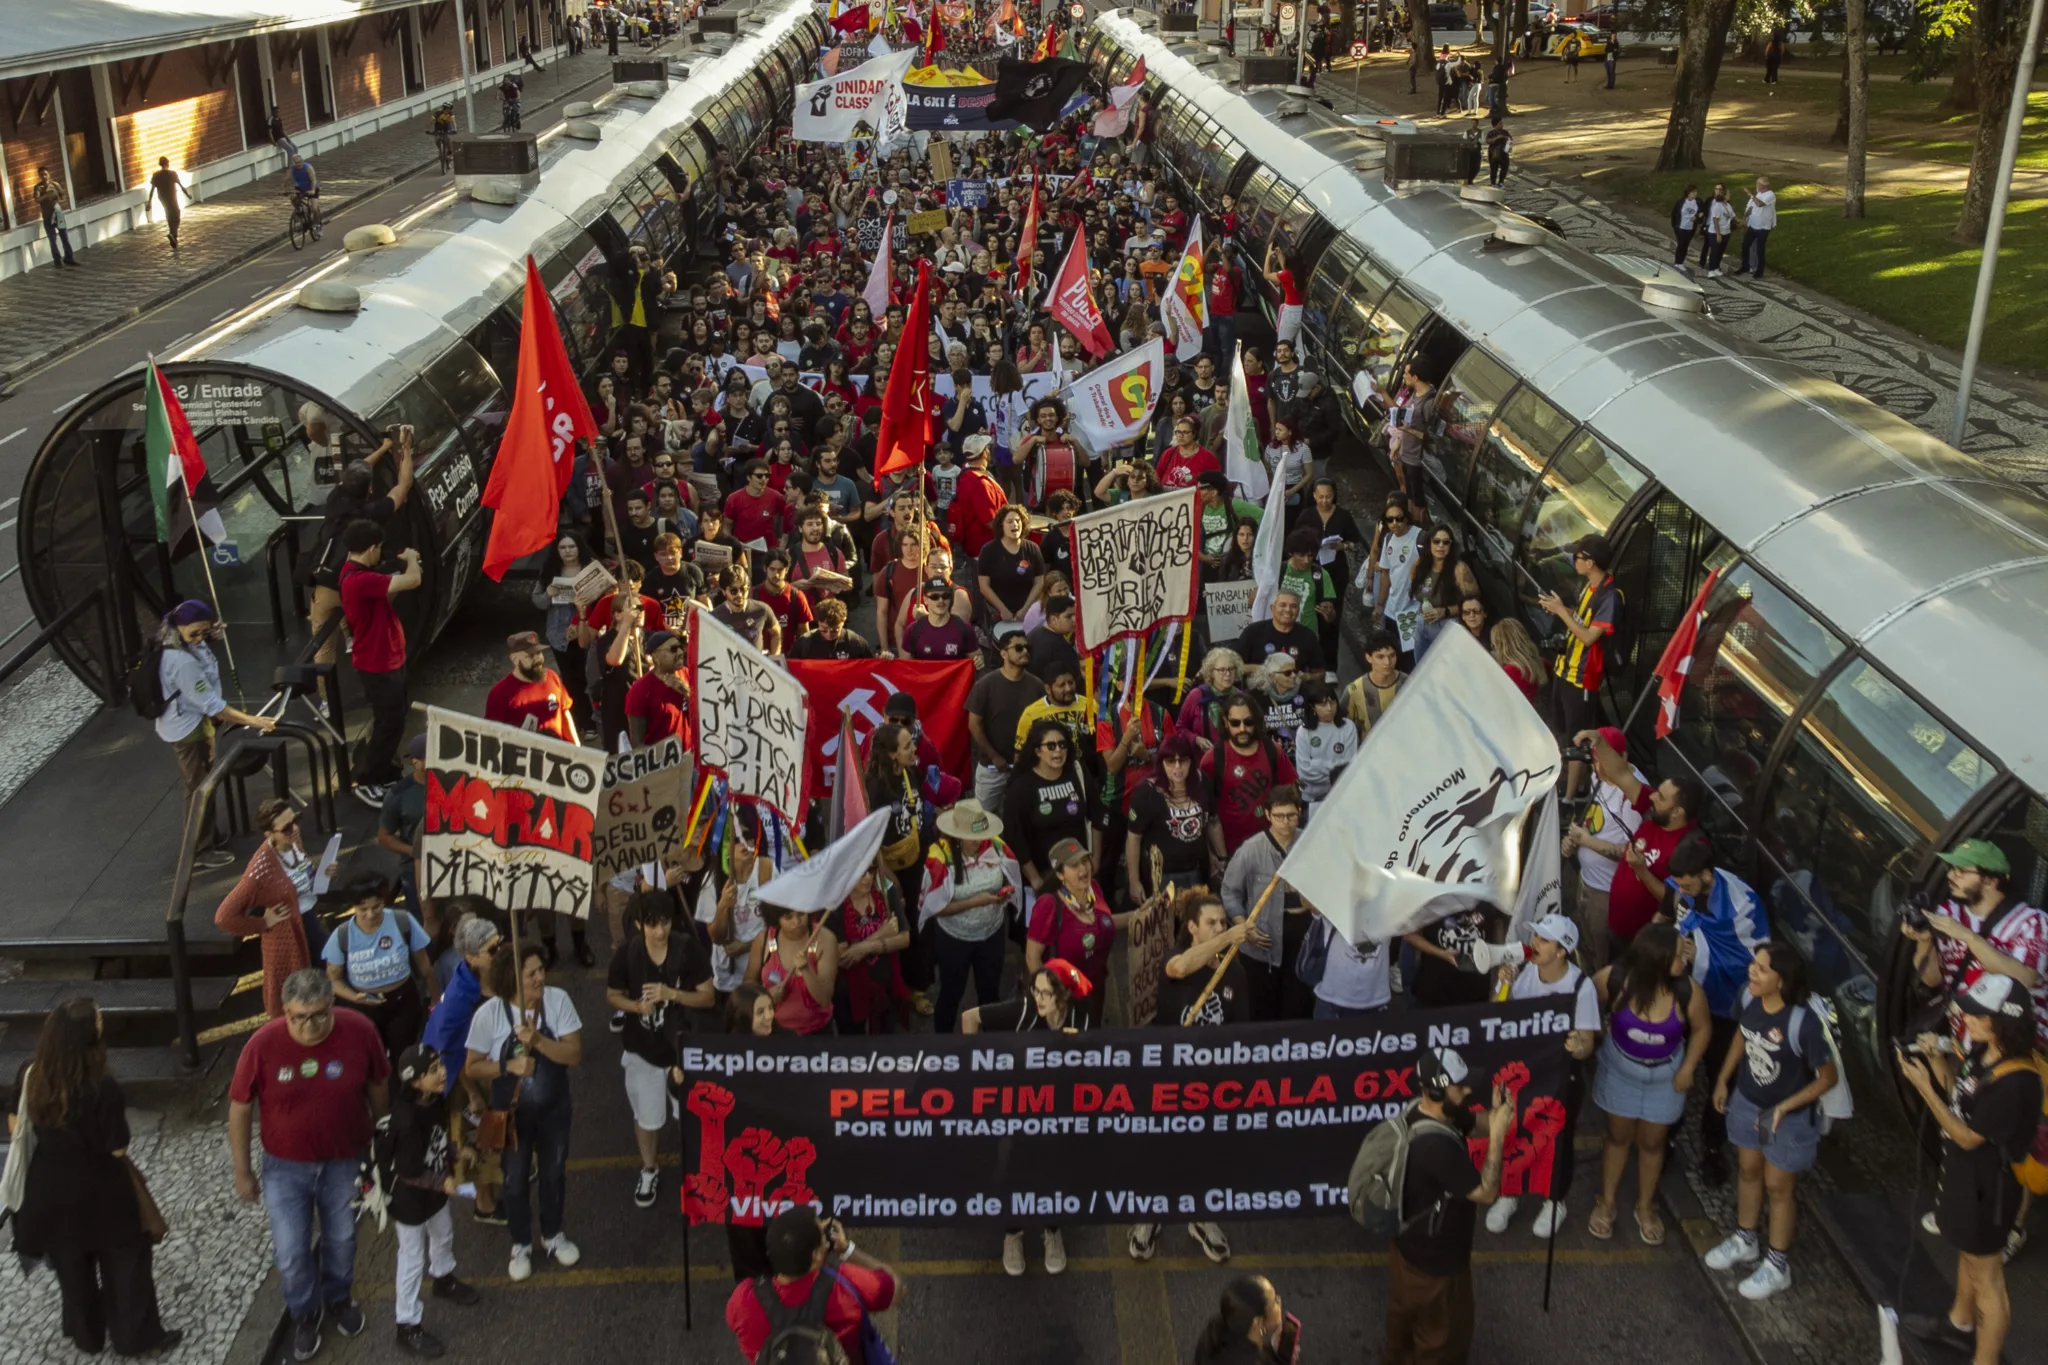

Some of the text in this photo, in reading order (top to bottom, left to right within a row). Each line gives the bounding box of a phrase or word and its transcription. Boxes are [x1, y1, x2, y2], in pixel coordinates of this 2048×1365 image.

[836, 79, 888, 95] UNIDAD
[836, 96, 872, 109] CLASS
[924, 96, 944, 108] 6X1
[859, 238, 906, 250] MODNA
[201, 384, 262, 399] Entrada
[181, 400, 212, 410] erminal
[216, 416, 241, 426] Santa
[456, 481, 479, 519] Correia
[1078, 522, 1115, 546] POR
[1097, 571, 1167, 613] TARIFA
[1208, 589, 1251, 604] TRABALH
[1208, 603, 1249, 616] TRABALH
[438, 724, 596, 794] DIREITO
[603, 740, 681, 789] SCALA
[1038, 781, 1075, 802] PUMA
[425, 769, 596, 866] MORAR
[1398, 767, 1466, 843] Movimento
[594, 822, 648, 857] DESU
[595, 842, 648, 880] MANO
[427, 848, 589, 918] DIREITOS
[349, 948, 375, 962] MEU
[351, 956, 391, 973] CORPO
[682, 1009, 1571, 1076] Exploradas/os/es Na Escala E Roubadas/os/es Na Tarifa
[830, 1088, 954, 1118] PELO
[972, 1084, 1055, 1114] FIM
[1073, 1083, 1135, 1113] DA
[1151, 1076, 1337, 1113] ESCALA
[835, 1119, 886, 1138] POR
[895, 1118, 933, 1137] UM
[940, 1116, 1090, 1137] TRASPORTE
[1097, 1112, 1205, 1134] PÚBLICO
[1213, 1114, 1228, 1132] E
[1237, 1112, 1268, 1131] DE
[833, 1193, 957, 1217] Primeiro
[966, 1191, 1001, 1216] de
[1011, 1190, 1080, 1215] Maio
[1088, 1190, 1097, 1215] /
[1106, 1189, 1168, 1215] Viva
[1178, 1195, 1195, 1213] a
[1205, 1187, 1301, 1213] Classe
